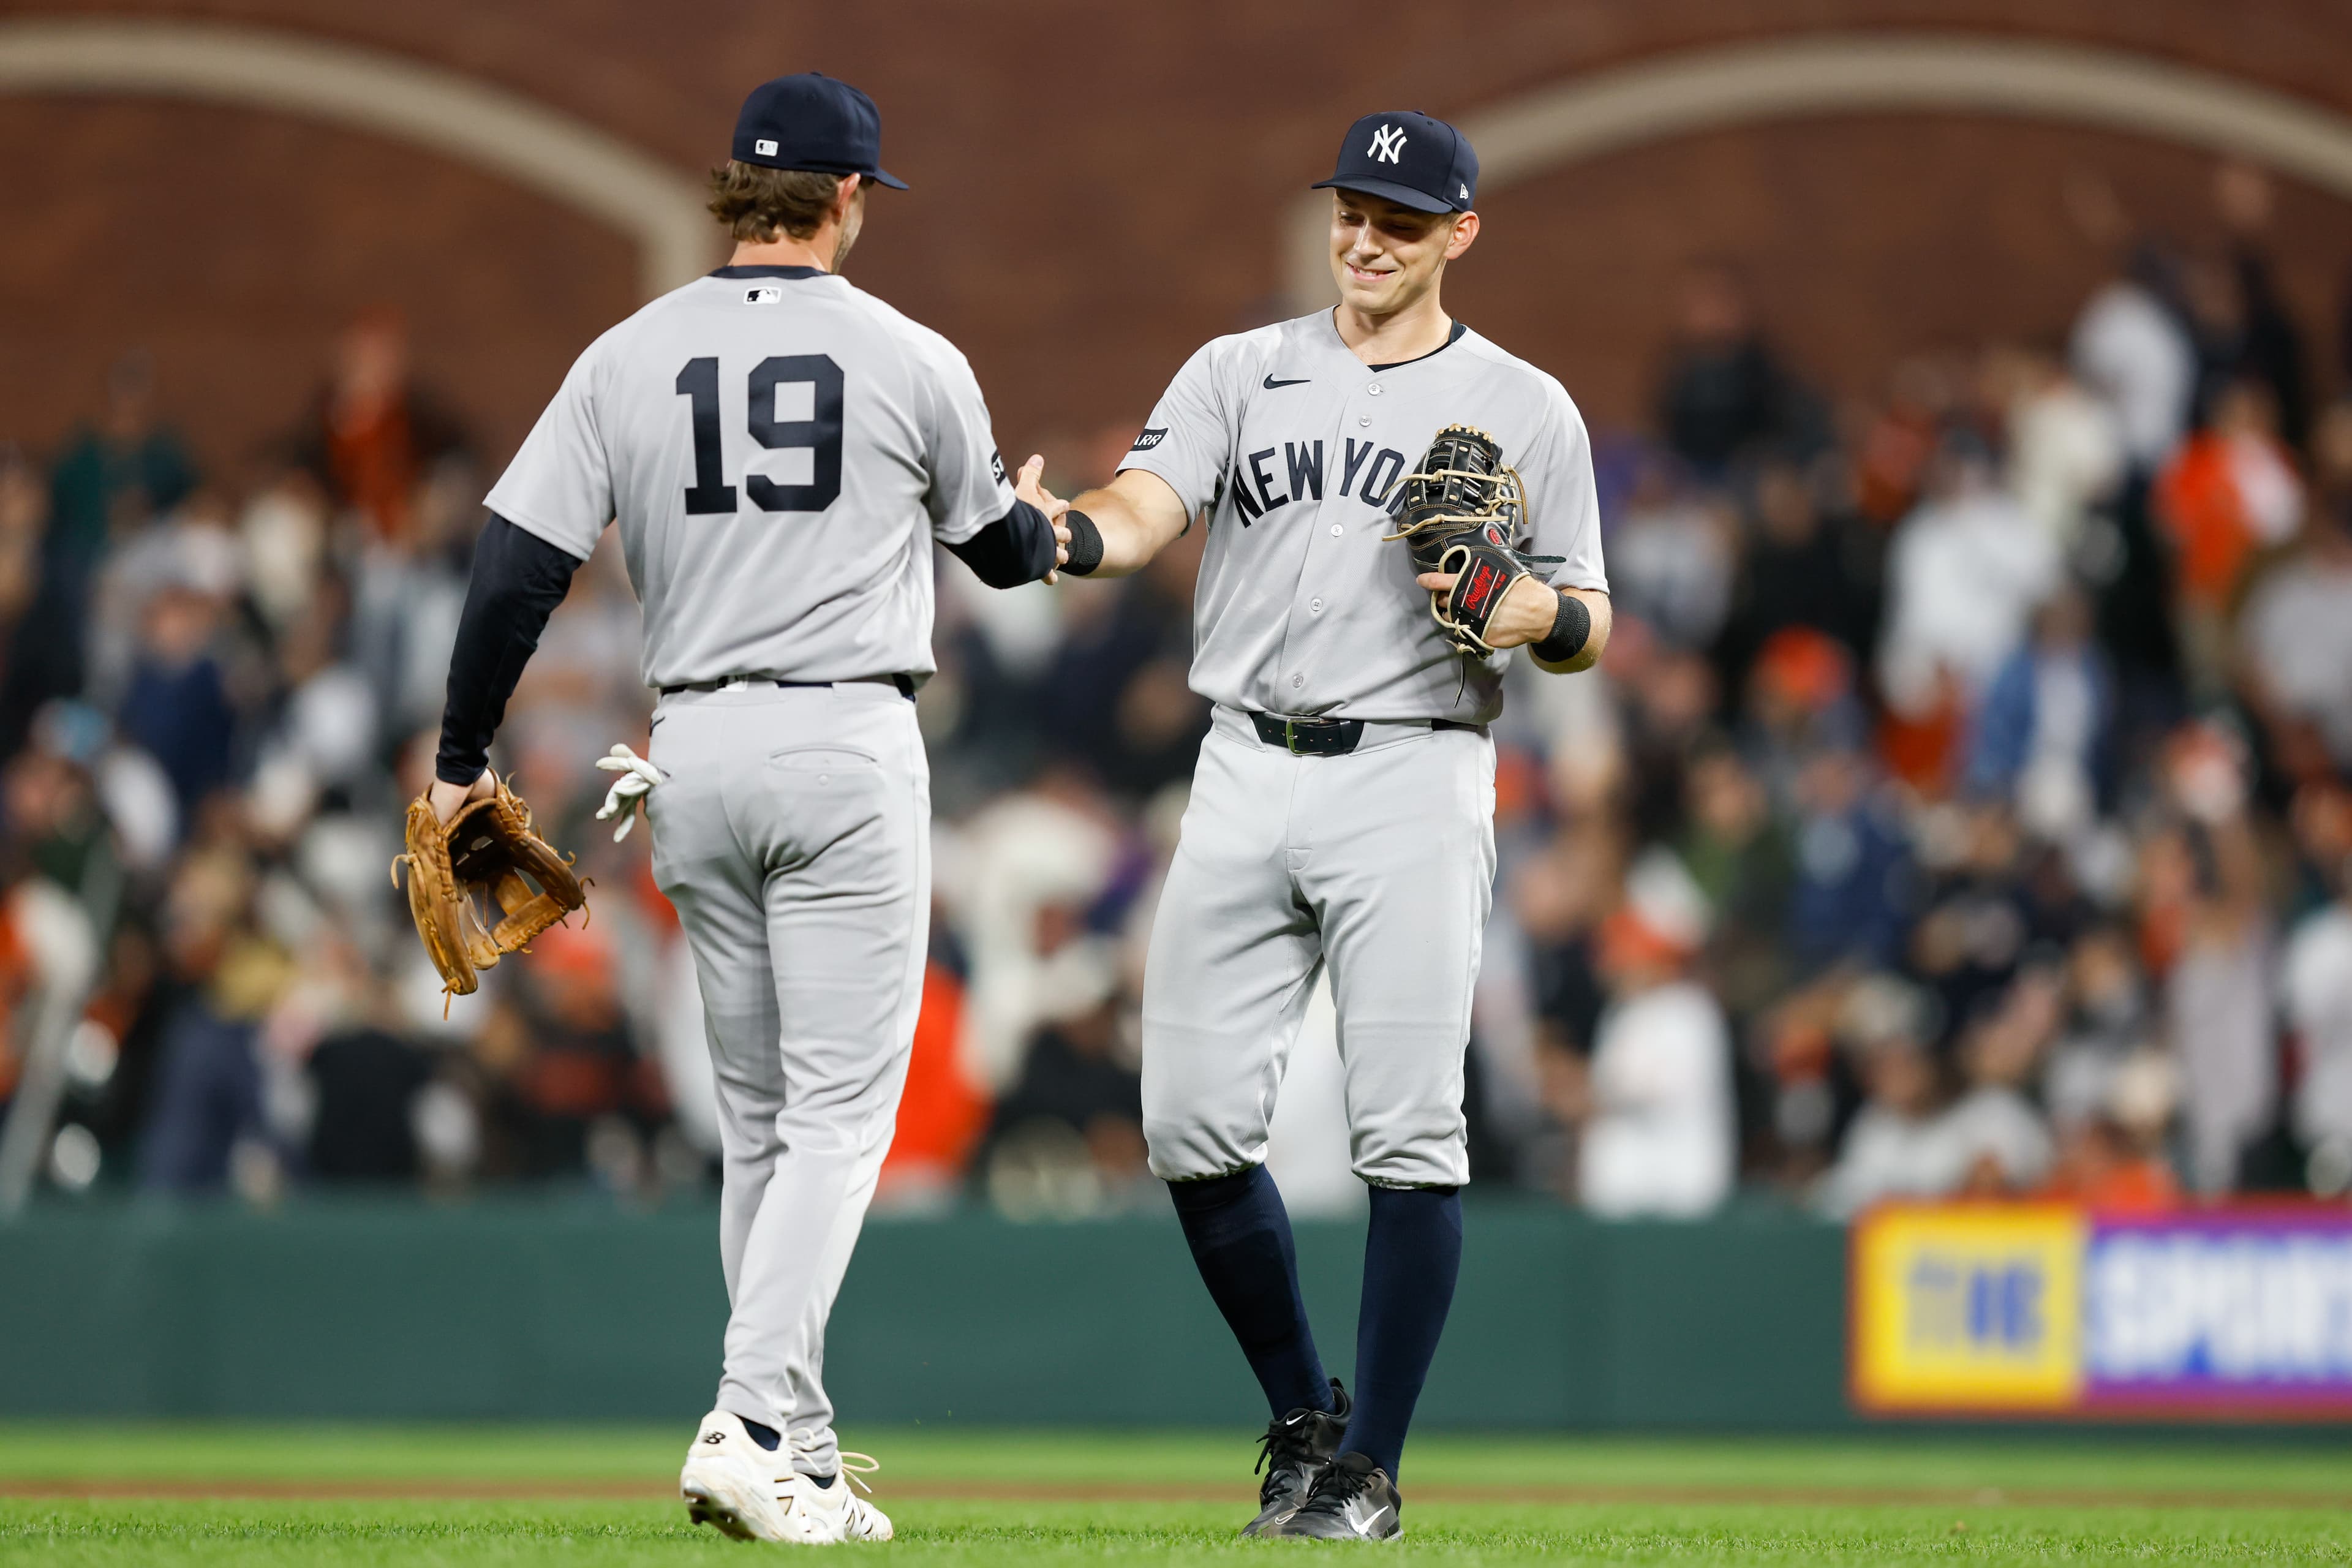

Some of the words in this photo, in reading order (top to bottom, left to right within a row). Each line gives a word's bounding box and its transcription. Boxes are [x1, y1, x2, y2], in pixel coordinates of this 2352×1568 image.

[1366, 124, 1408, 165] NY
[676, 353, 844, 514] 19
[1233, 440, 1323, 529] NEW
[1466, 565, 1493, 610] Rawlings
